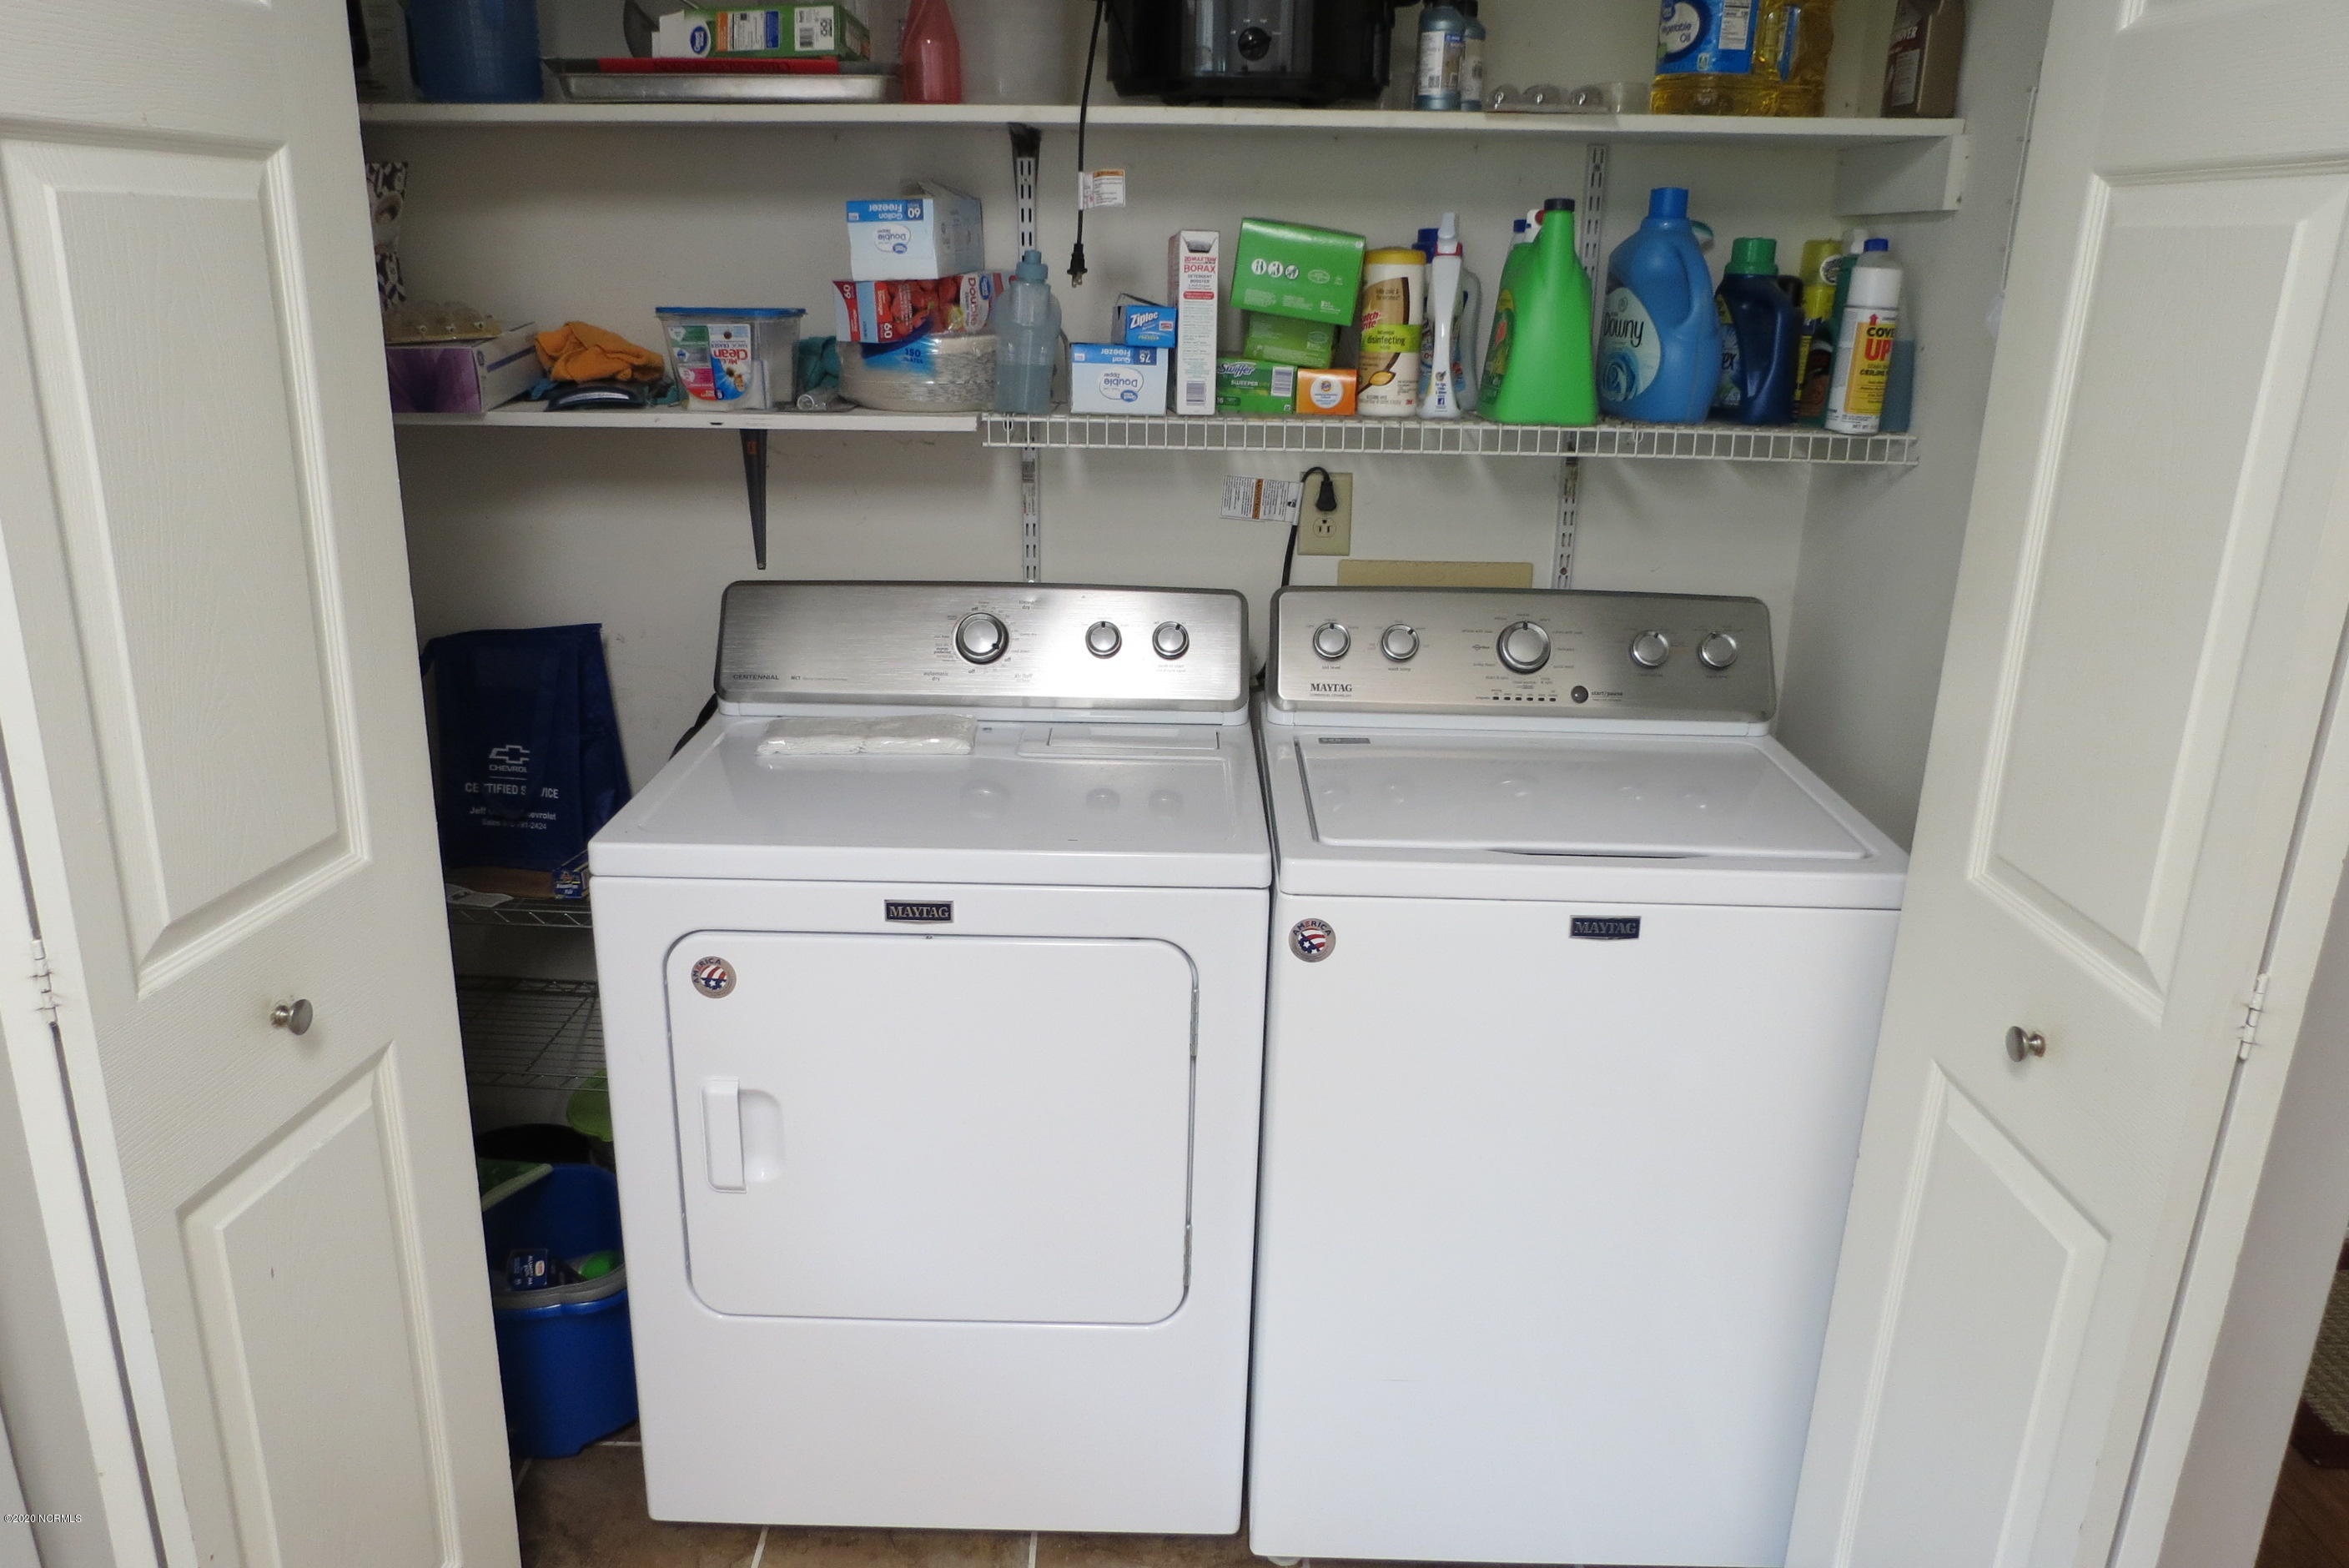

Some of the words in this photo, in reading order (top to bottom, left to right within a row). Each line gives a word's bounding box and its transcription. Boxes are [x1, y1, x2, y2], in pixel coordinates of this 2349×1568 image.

[908, 209, 921, 219] 60
[1184, 264, 1216, 274] BORAX
[968, 277, 977, 327] Double
[1129, 312, 1159, 329] Ziploc
[883, 323, 893, 339] 60
[1603, 313, 1644, 348] Downy
[714, 349, 748, 360] Clean
[1864, 338, 1894, 361] UP
[1139, 354, 1151, 363] 75
[1217, 362, 1255, 377] Swiffer
[1104, 378, 1138, 388] Double
[1310, 683, 1352, 692] MAYTAG
[465, 781, 518, 795] CETIFIED
[888, 906, 949, 917] MAYTAG
[1293, 921, 1331, 936] AMERICA
[1574, 922, 1636, 934] MAYTAG
[692, 957, 721, 983] AMERICA
